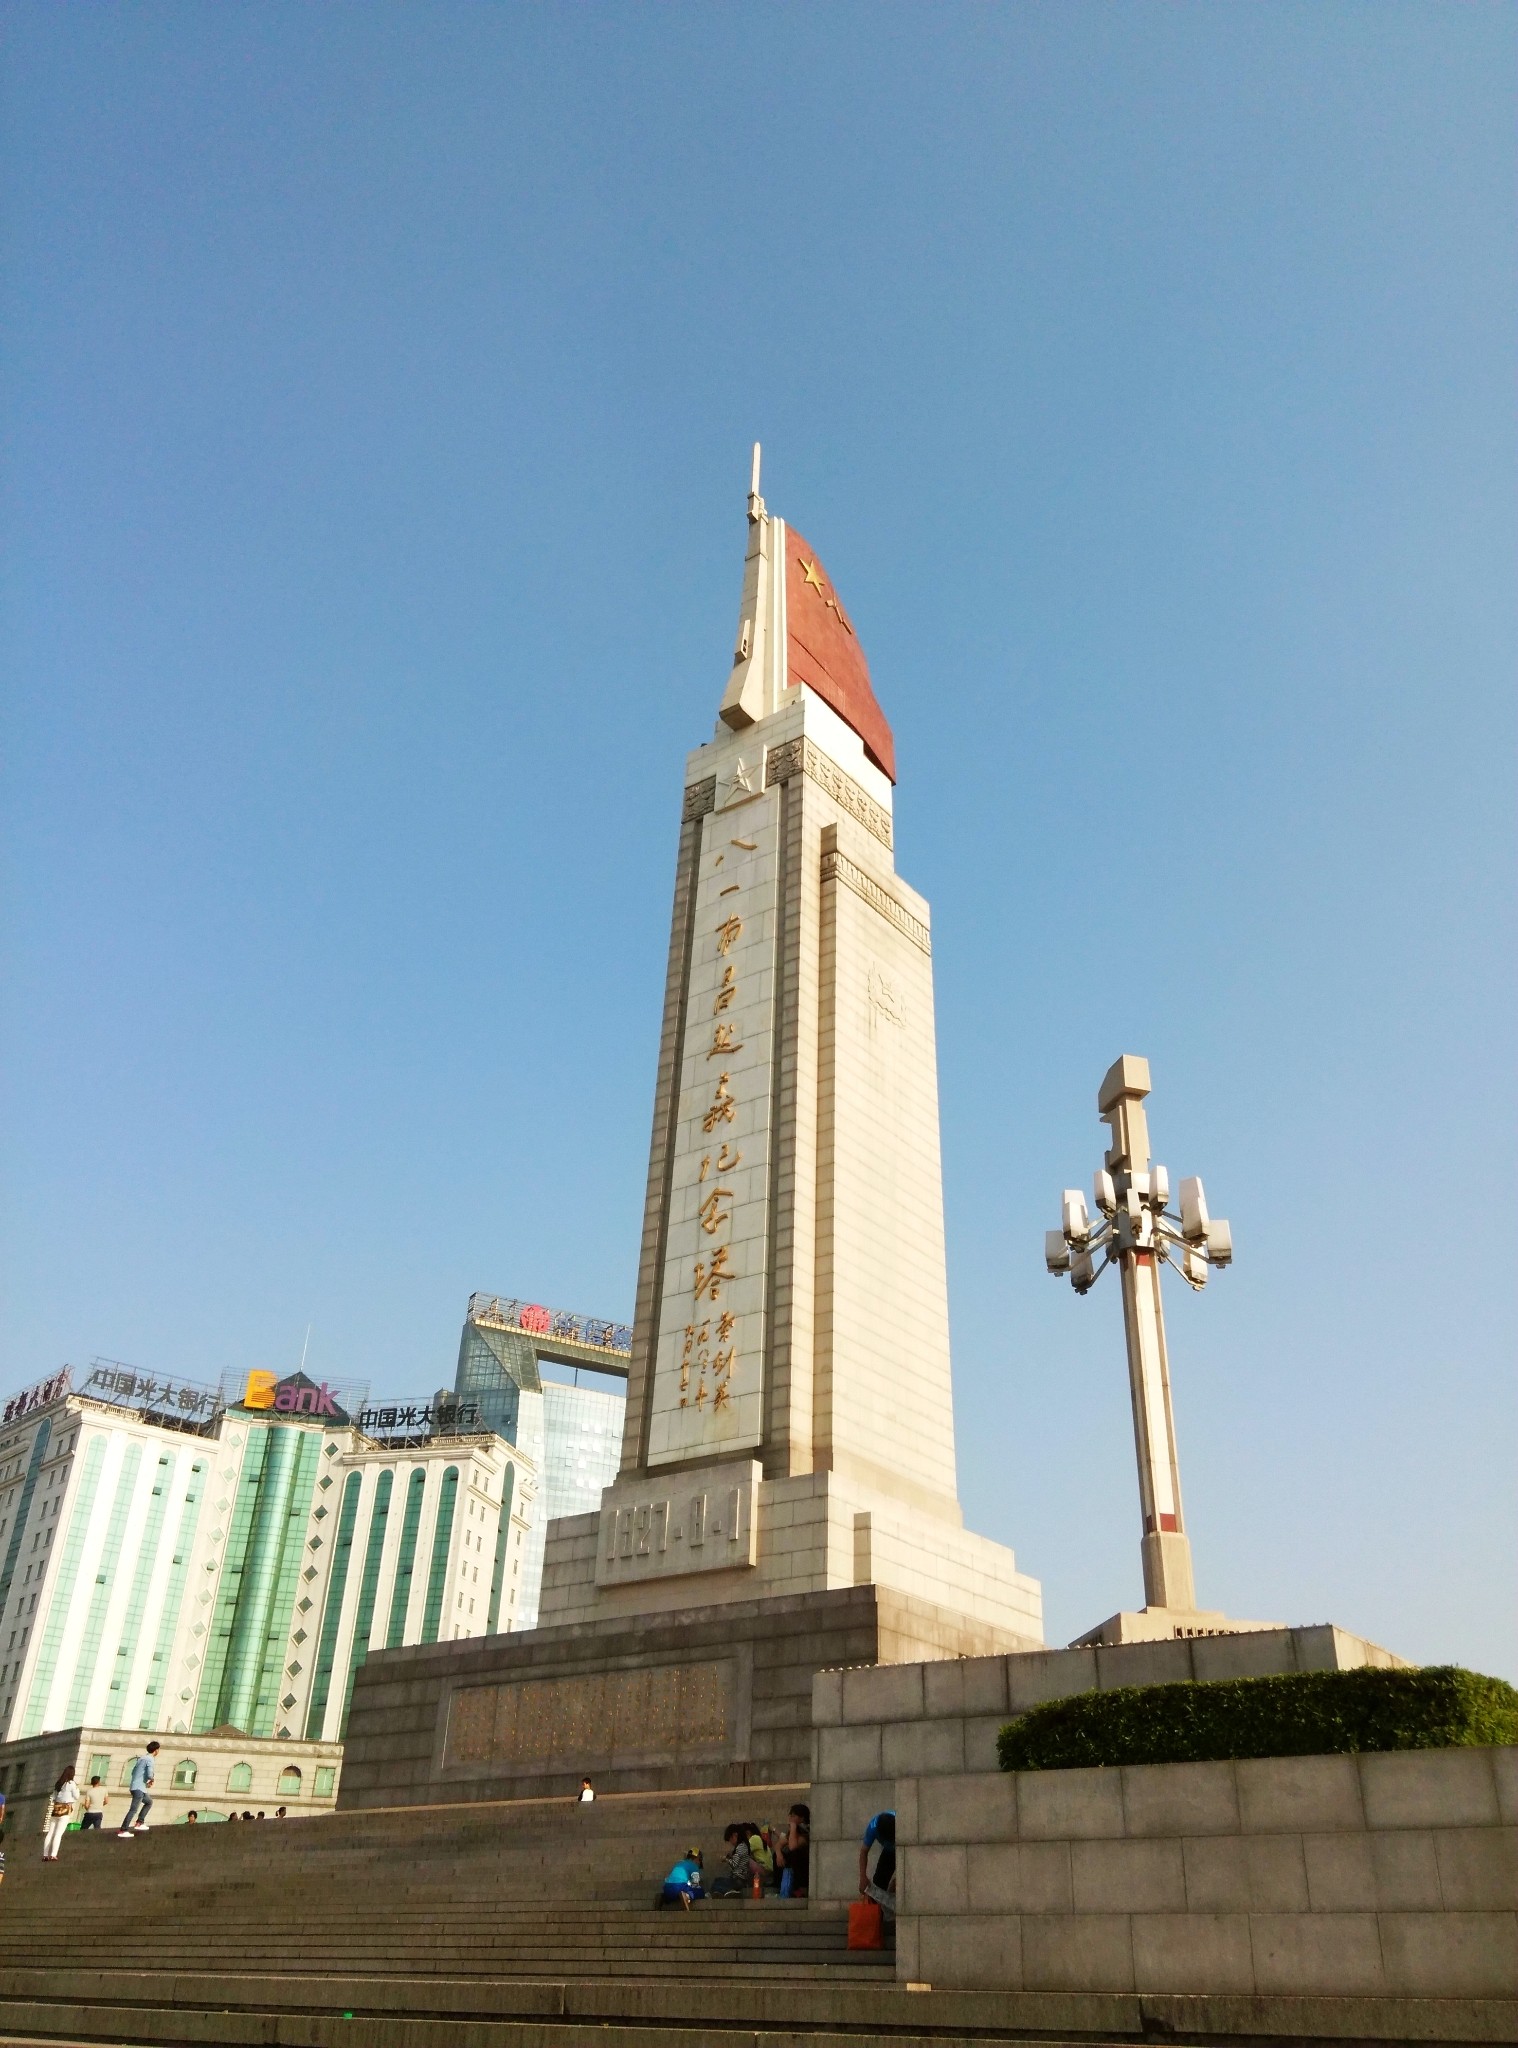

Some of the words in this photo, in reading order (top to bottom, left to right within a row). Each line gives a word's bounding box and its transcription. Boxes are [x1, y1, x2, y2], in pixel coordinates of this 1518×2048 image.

[92, 1368, 220, 1417] 中国光大银行
[243, 1368, 341, 1416] Bank
[359, 1403, 478, 1429] 中国光大银行
[606, 1488, 740, 1560] 1927.8.1
